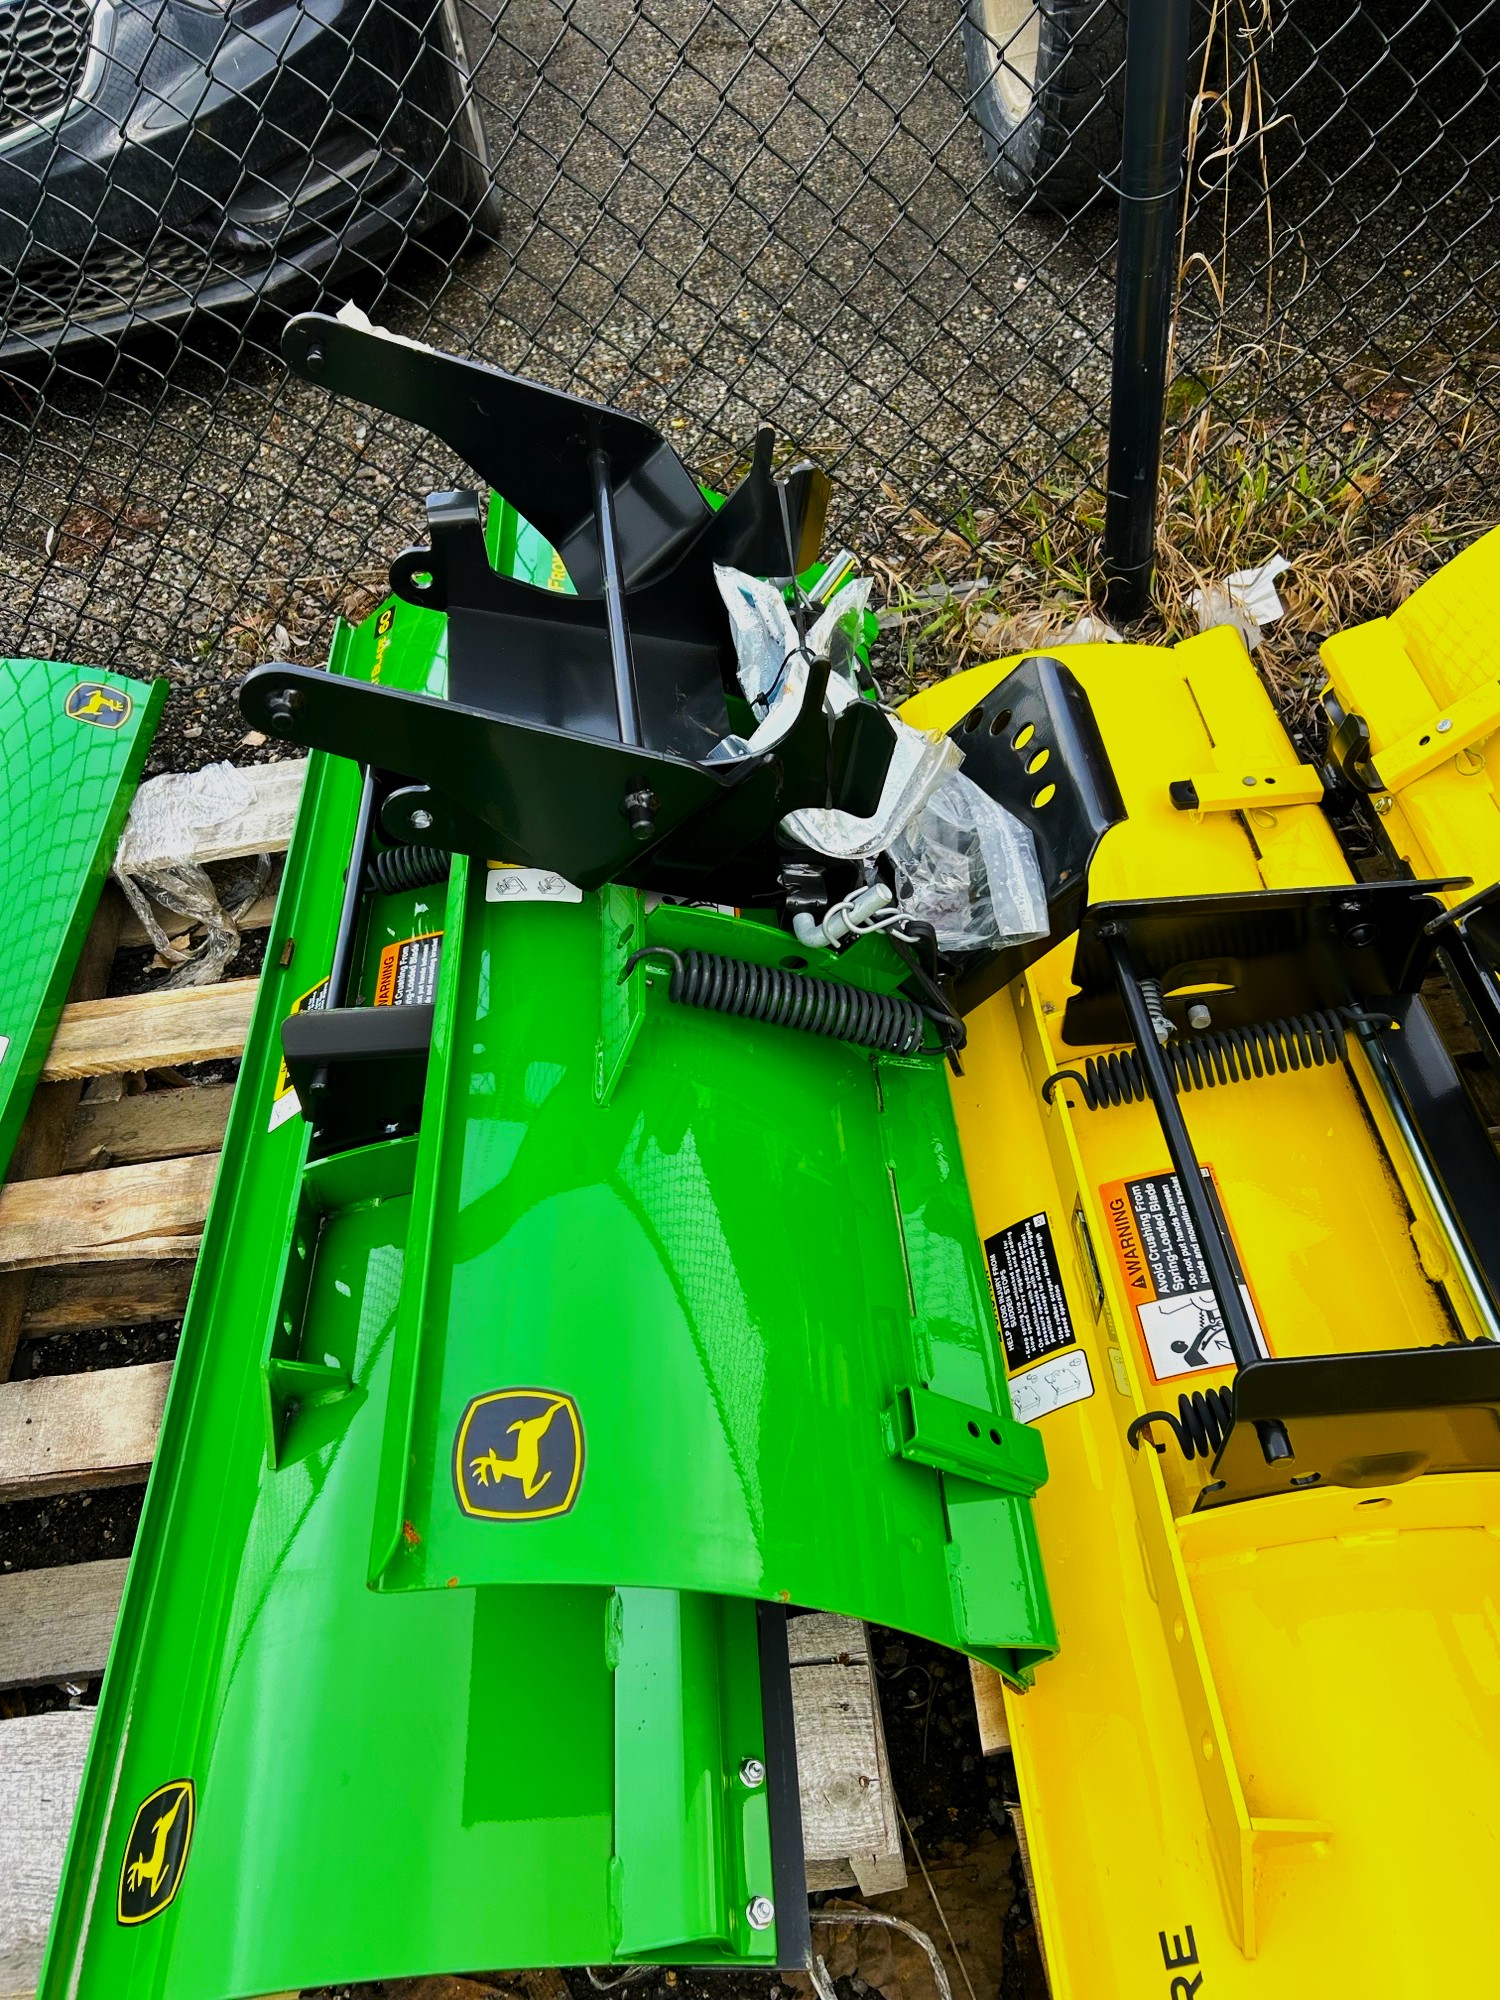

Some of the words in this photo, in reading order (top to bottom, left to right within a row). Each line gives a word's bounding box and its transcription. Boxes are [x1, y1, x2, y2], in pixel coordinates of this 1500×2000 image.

[378, 610, 391, 634] 60
[400, 946, 409, 965] From
[1132, 1185, 1146, 1212] From
[1145, 1183, 1161, 1212] Blade
[1161, 1184, 1178, 1216] between
[1170, 1176, 1186, 1204] bracket
[1025, 1222, 1034, 1245] digging
[1110, 1198, 1142, 1276] WARNING
[1140, 1213, 1161, 1261] Crushing
[1171, 1217, 1183, 1242] hands
[1007, 1232, 1016, 1255] grading
[1152, 1213, 1185, 1291] Spring-Loaded
[1178, 1243, 1191, 1256] put
[1190, 1243, 1202, 1259] and
[990, 1254, 999, 1276] FROM
[1005, 1250, 1013, 1270] except
[1029, 1247, 1038, 1265] speed
[1042, 1259, 1050, 1276] blade
[1183, 1258, 1194, 1272] not
[1000, 1269, 1010, 1295] STOPS
[1015, 1269, 1023, 1293] digging
[1021, 1260, 1031, 1289] hydraulic
[1152, 1263, 1170, 1293] Avoid
[1188, 1273, 1198, 1285] Do
[1197, 1260, 1210, 1283] blade
[994, 1278, 1005, 1304] INJURY
[1009, 1272, 1019, 1300] unlocked
[1046, 1278, 1055, 1302] scraper
[1005, 1295, 1017, 1328] SUDDEN
[1034, 1290, 1043, 1315] operate
[1040, 1292, 1049, 1315] except
[1054, 1285, 1066, 1316] operation
[1000, 1305, 1010, 1328] AVOID
[1019, 1314, 1027, 1336] spring
[1025, 1315, 1033, 1334] speed
[1031, 1305, 1041, 1336] machines
[1052, 1304, 1060, 1325] rubber
[1040, 1316, 1050, 1345] pressure
[1046, 1316, 1056, 1343] position
[1061, 1317, 1070, 1337] speed
[1005, 1330, 1014, 1351] HELP
[1038, 1337, 1044, 1348] On
